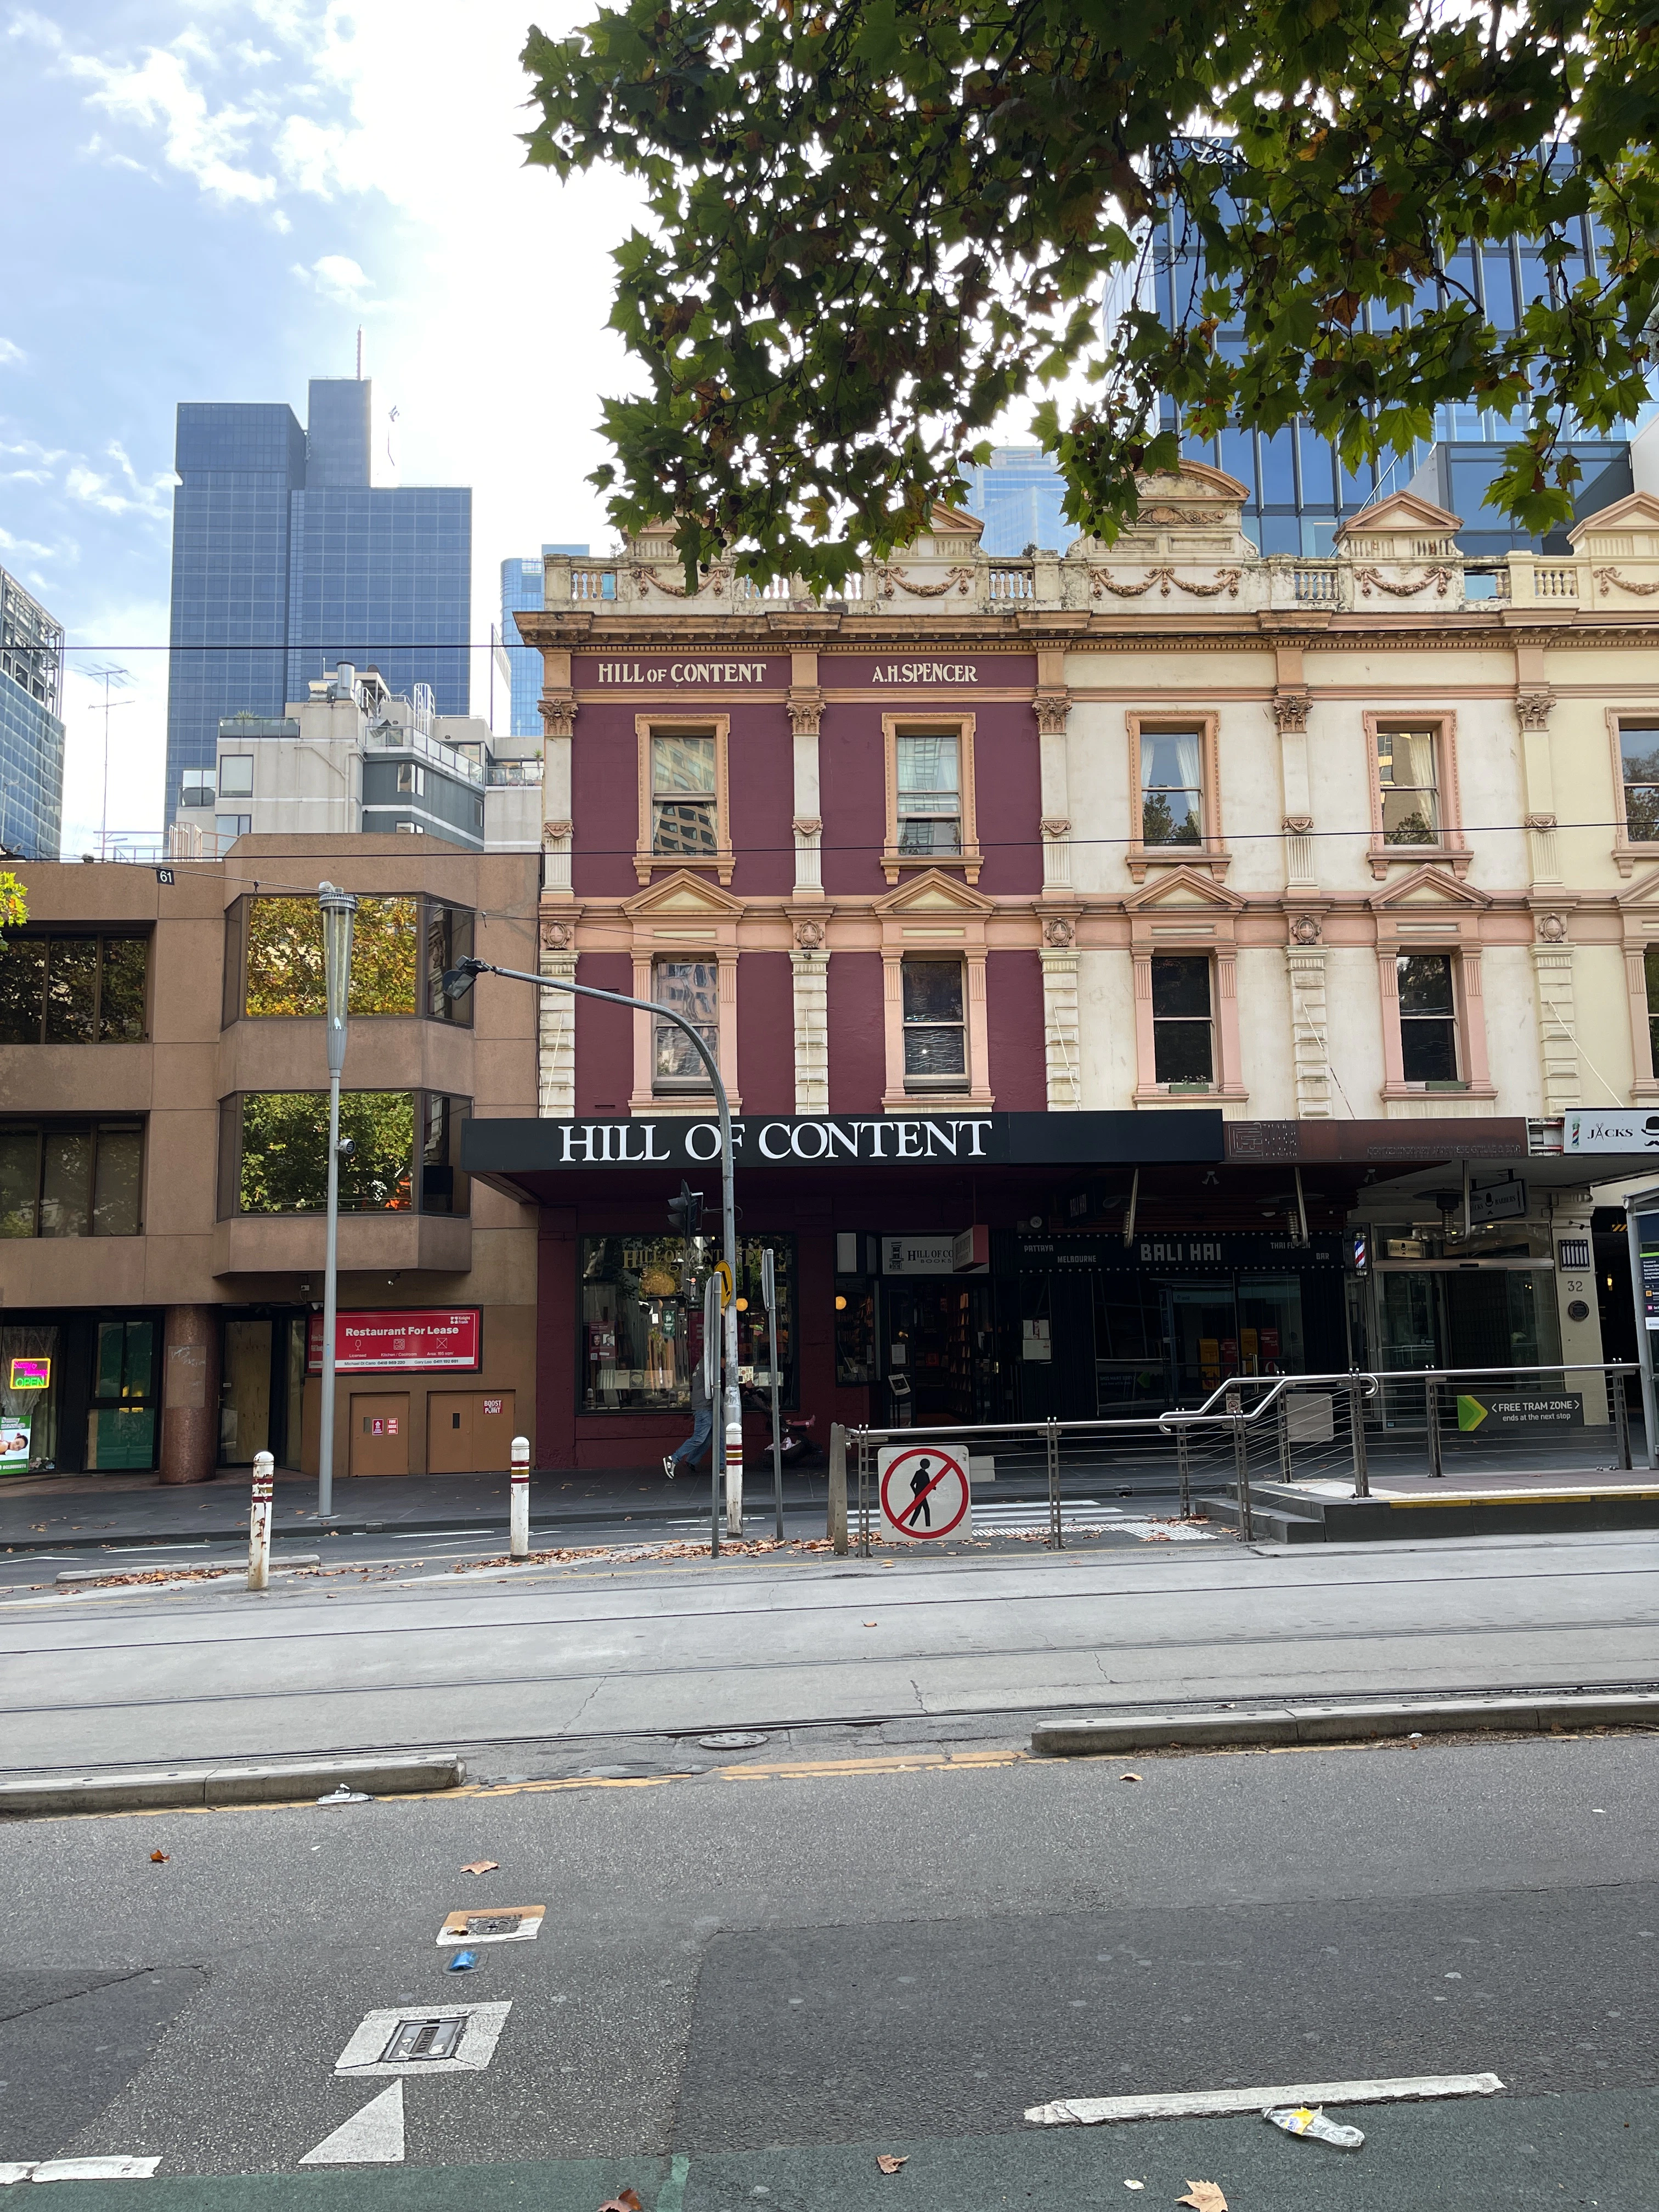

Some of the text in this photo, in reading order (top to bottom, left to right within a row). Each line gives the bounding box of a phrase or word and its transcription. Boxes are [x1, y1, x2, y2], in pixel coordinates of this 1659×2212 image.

[598, 663, 767, 683] HILL OF CONTENT
[160, 870, 172, 883] 61
[1587, 1122, 1633, 1141] JACKS
[558, 1124, 670, 1161] HILL
[758, 1120, 993, 1159] CONTENT
[1024, 1244, 1054, 1252] PATTAYA
[1270, 1242, 1285, 1250] THAI
[907, 1250, 930, 1261] HILL
[1141, 1243, 1221, 1262] BALI HAI
[623, 1250, 661, 1268] HILL
[1057, 1255, 1097, 1263] MELBOURNE
[1567, 1280, 1583, 1292] 32
[346, 1326, 459, 1336] Restaurant For Lease
[15, 1377, 44, 1387] OPEN
[1498, 1401, 1572, 1412] FREE TRAM ZONE
